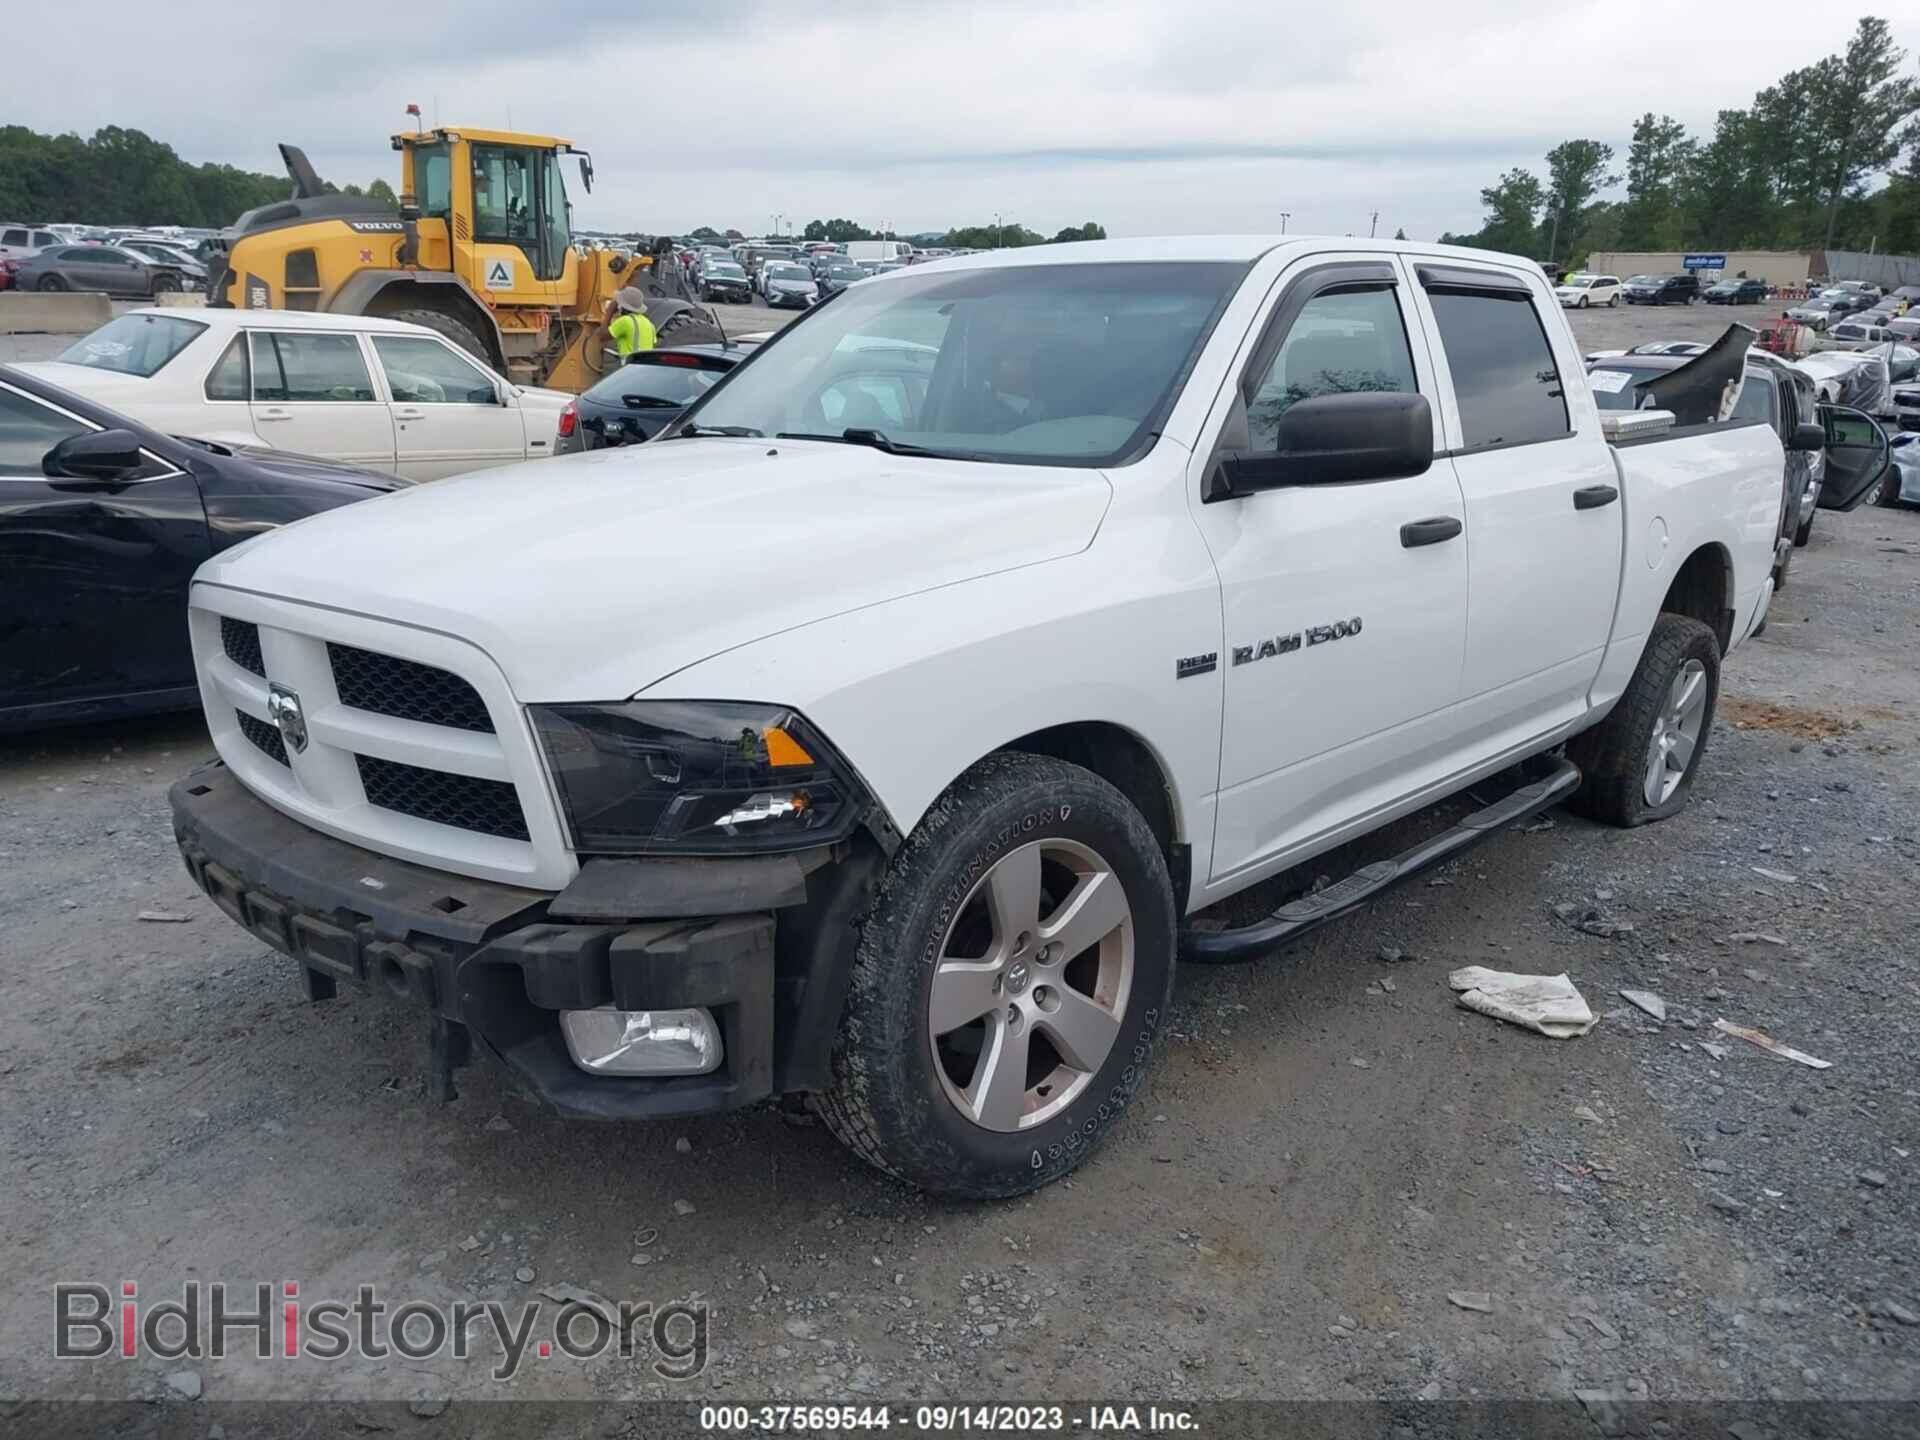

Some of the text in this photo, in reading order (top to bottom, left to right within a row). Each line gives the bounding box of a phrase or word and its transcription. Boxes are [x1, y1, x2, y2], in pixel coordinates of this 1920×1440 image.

[353, 222, 402, 230] VOLVO
[1232, 617, 1362, 666] RAM 1500
[921, 807, 1055, 963] DESTINATION
